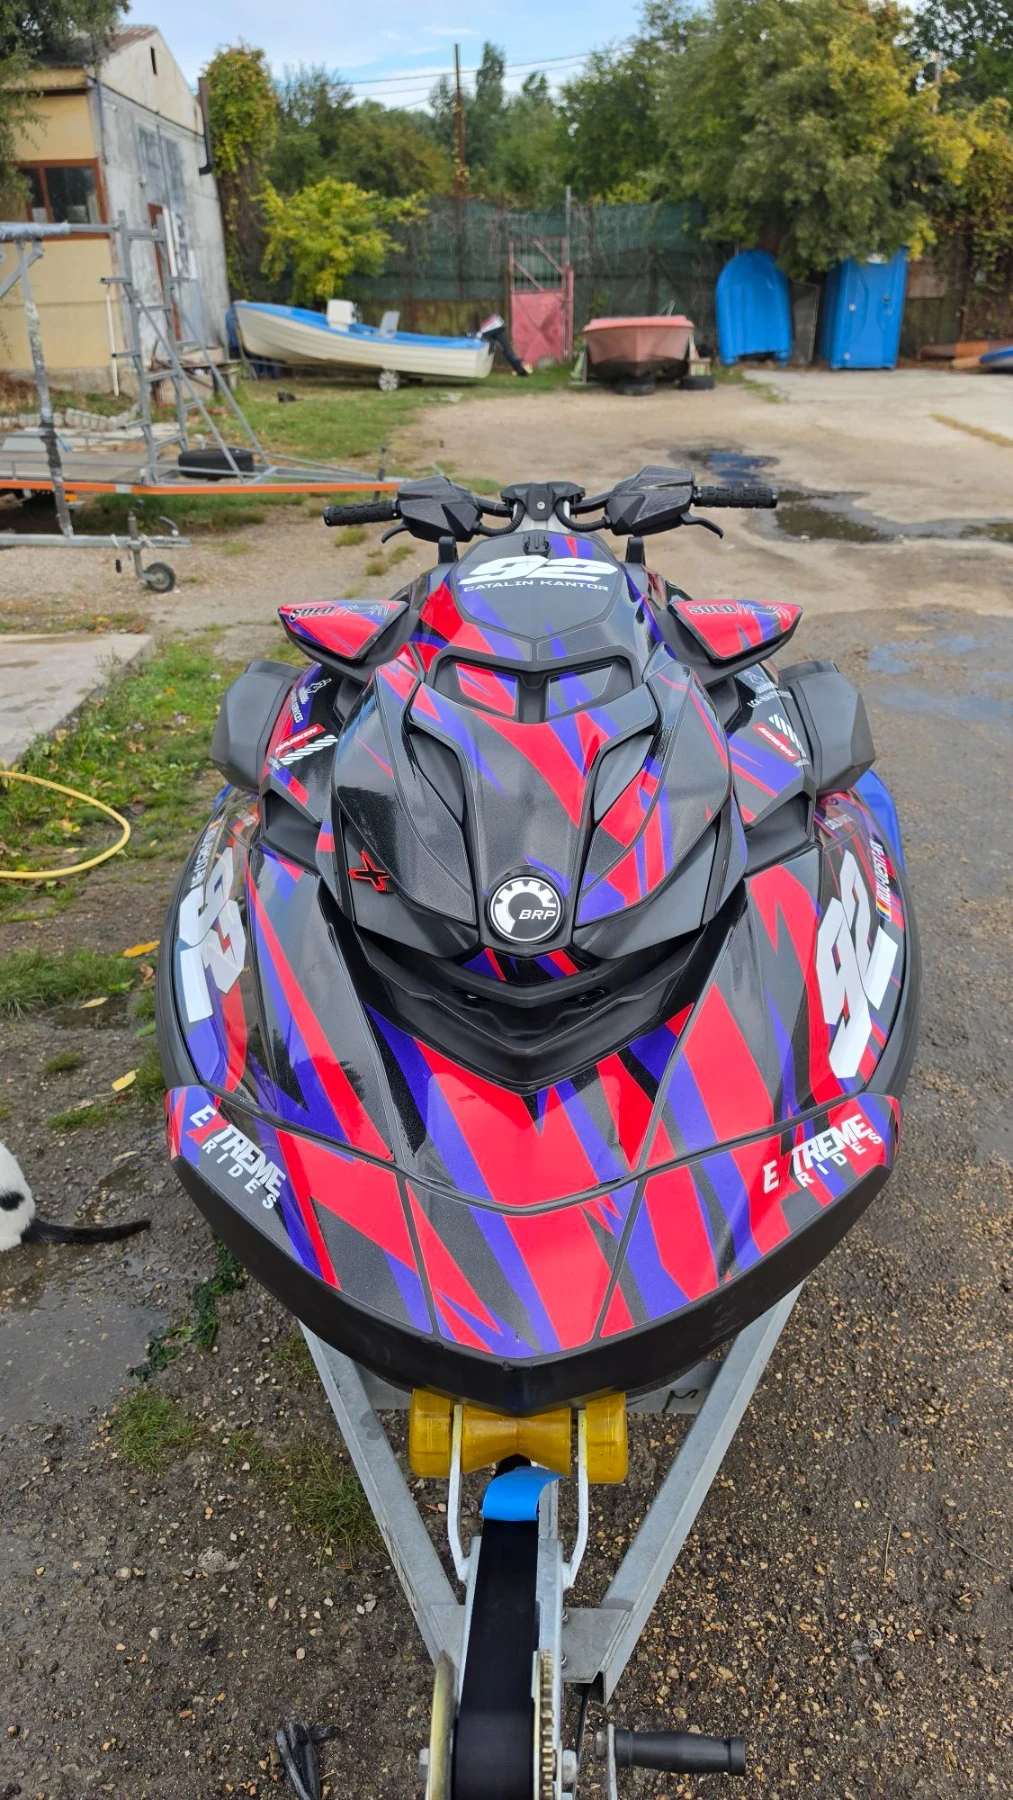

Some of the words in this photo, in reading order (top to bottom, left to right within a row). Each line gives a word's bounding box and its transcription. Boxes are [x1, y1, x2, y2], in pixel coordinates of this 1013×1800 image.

[458, 555, 619, 585] 92
[463, 580, 534, 593] CATALIN
[540, 580, 609, 592] KANTOR
[686, 603, 738, 614] SOLO
[518, 909, 557, 920] BRP
[186, 1104, 287, 1198] EXTREME
[796, 1128, 883, 1188] RIDES
[201, 1139, 277, 1209] RIDES
